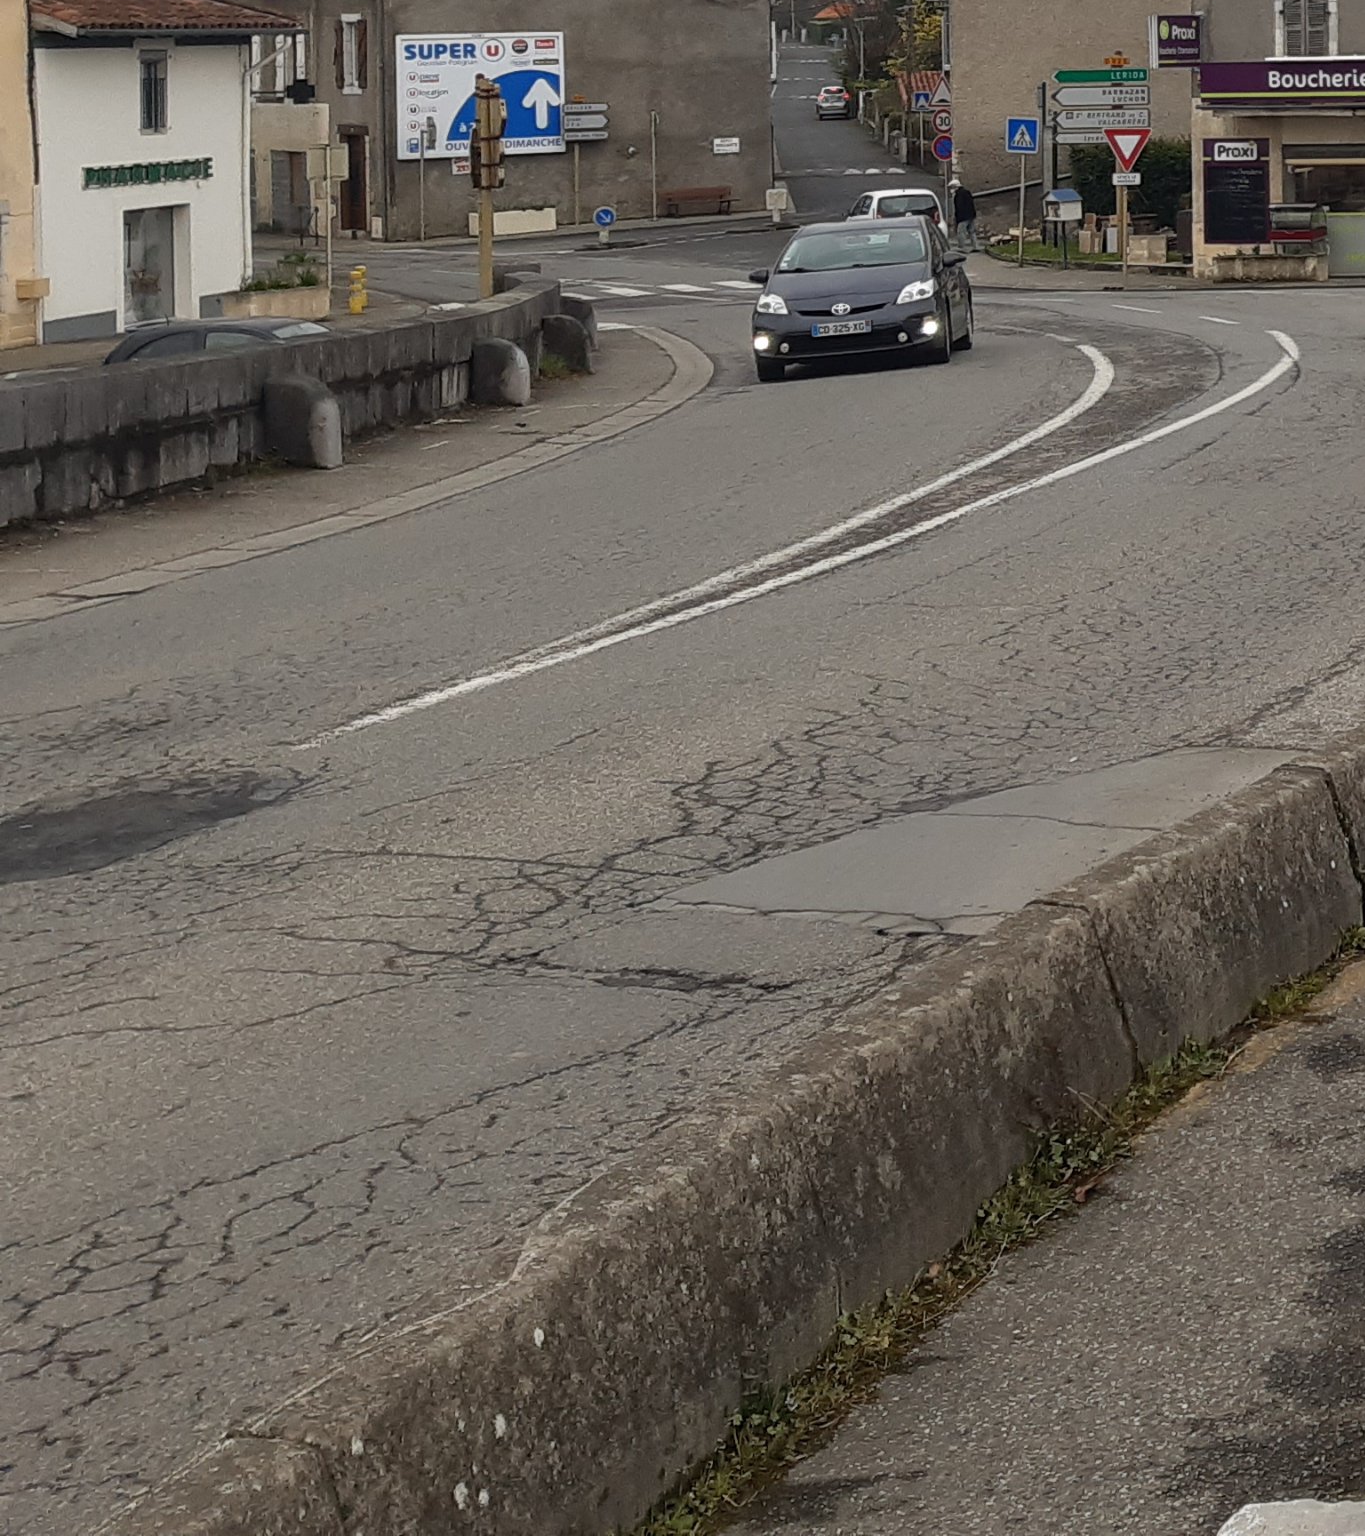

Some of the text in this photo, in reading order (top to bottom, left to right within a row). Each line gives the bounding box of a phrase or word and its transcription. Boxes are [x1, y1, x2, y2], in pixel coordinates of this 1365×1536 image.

[1171, 20, 1197, 40] Proxi
[404, 43, 477, 61] SUPER
[1110, 71, 1145, 80] LERIDA
[1102, 88, 1146, 96] BARBAZAN
[938, 115, 950, 127] 30
[504, 138, 562, 149] DIMANCHE
[1217, 141, 1255, 158] Proxi
